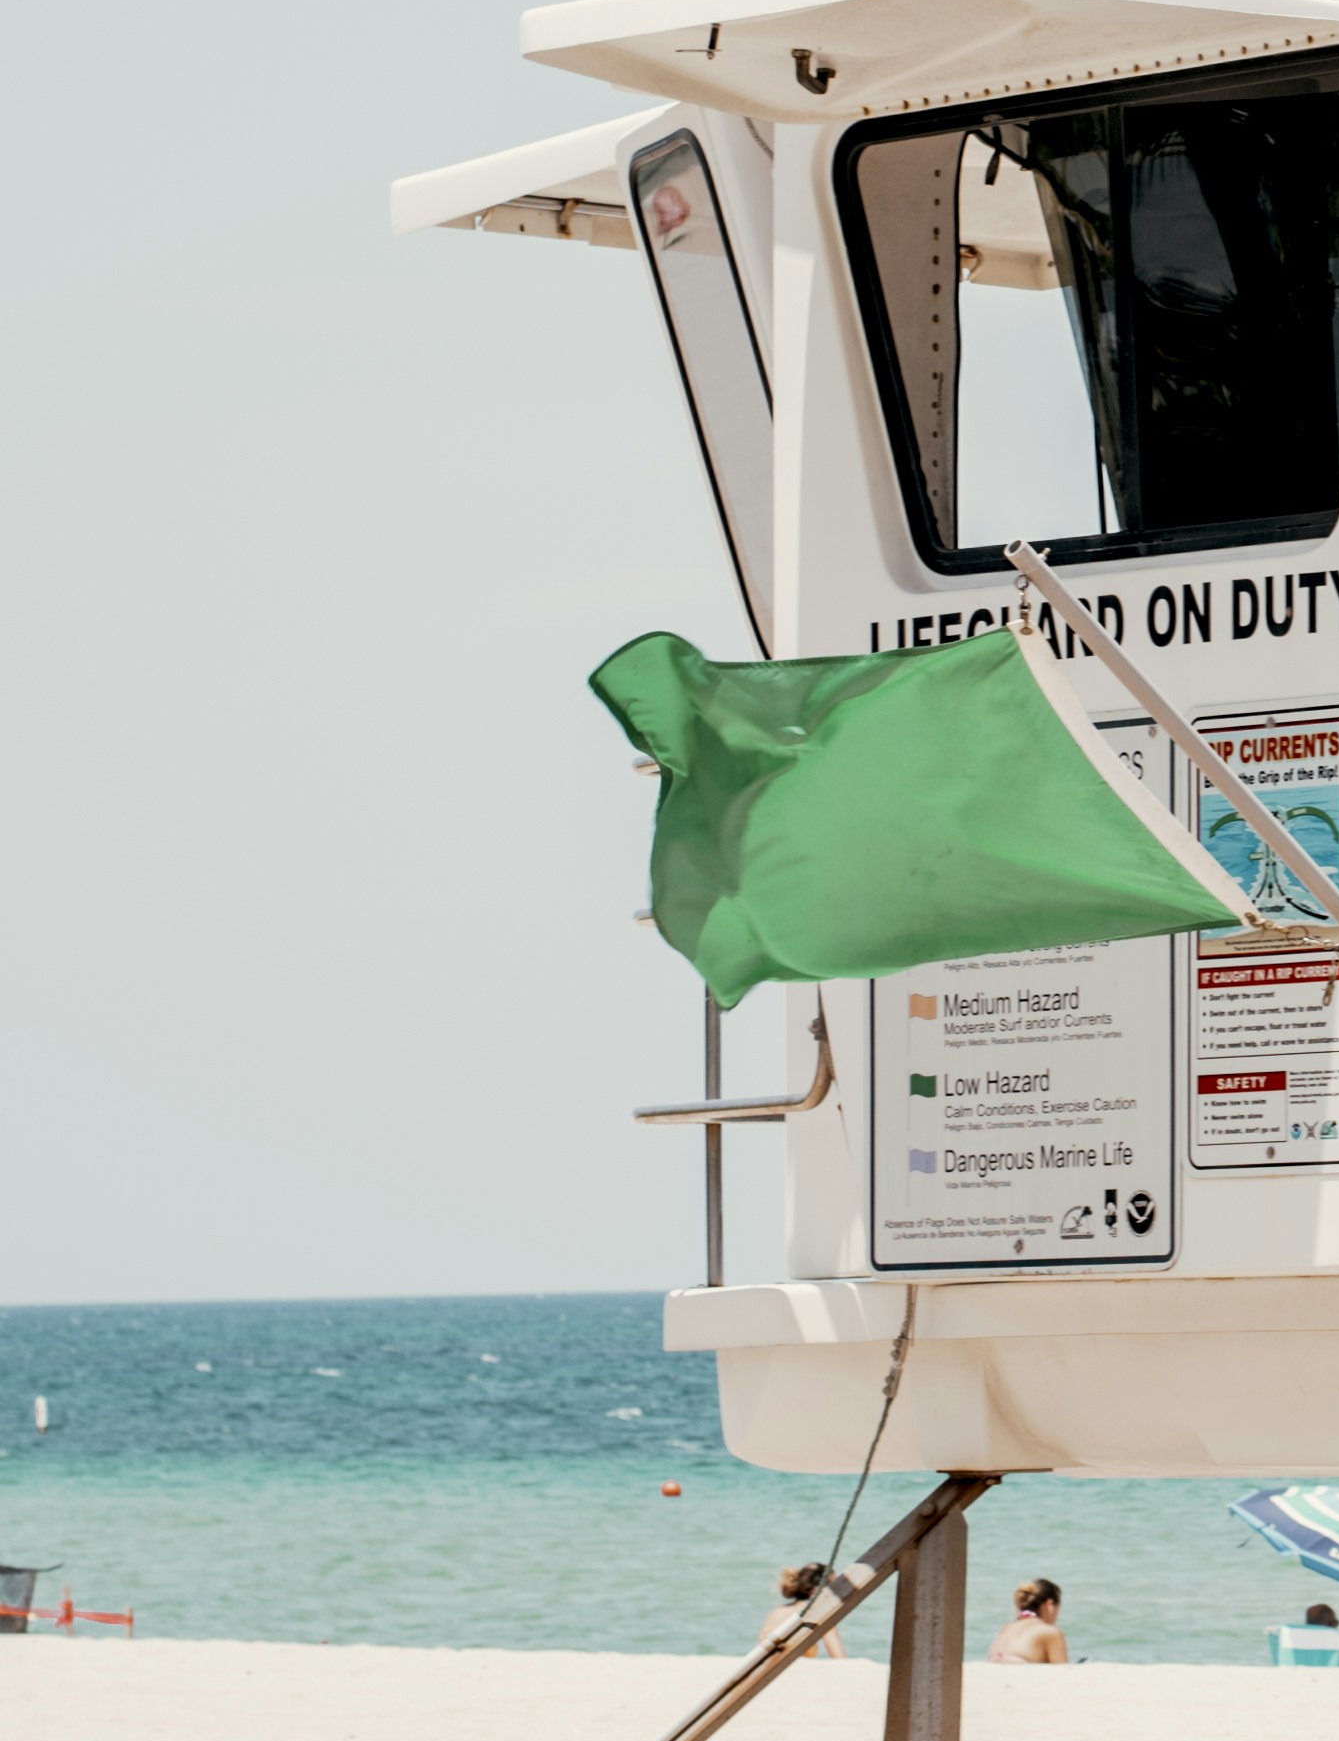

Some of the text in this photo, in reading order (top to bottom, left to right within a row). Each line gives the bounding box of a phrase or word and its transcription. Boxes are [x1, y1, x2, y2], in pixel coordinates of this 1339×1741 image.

[1146, 581, 1212, 648] ON
[1240, 731, 1339, 764] CURRENTS
[1258, 770, 1280, 786] Grip
[1284, 768, 1294, 781] of
[1297, 767, 1314, 780] the
[1317, 765, 1338, 782] Rip!
[1201, 973, 1211, 984] IF
[1212, 970, 1252, 983] CAUGHT
[1254, 969, 1265, 980] IN
[1266, 969, 1275, 980] A
[1276, 968, 1292, 979] RIP
[944, 986, 1079, 1018] Medium Hazard
[944, 1013, 1112, 1035] Moderate Surf and/or Currents
[945, 1068, 1049, 1096] Low Hazard
[1216, 1076, 1267, 1089] SAFETY
[945, 1097, 1136, 1118] Calm Conditions, Exercise Caution
[945, 1142, 1133, 1178] Dangerous Marine Life
